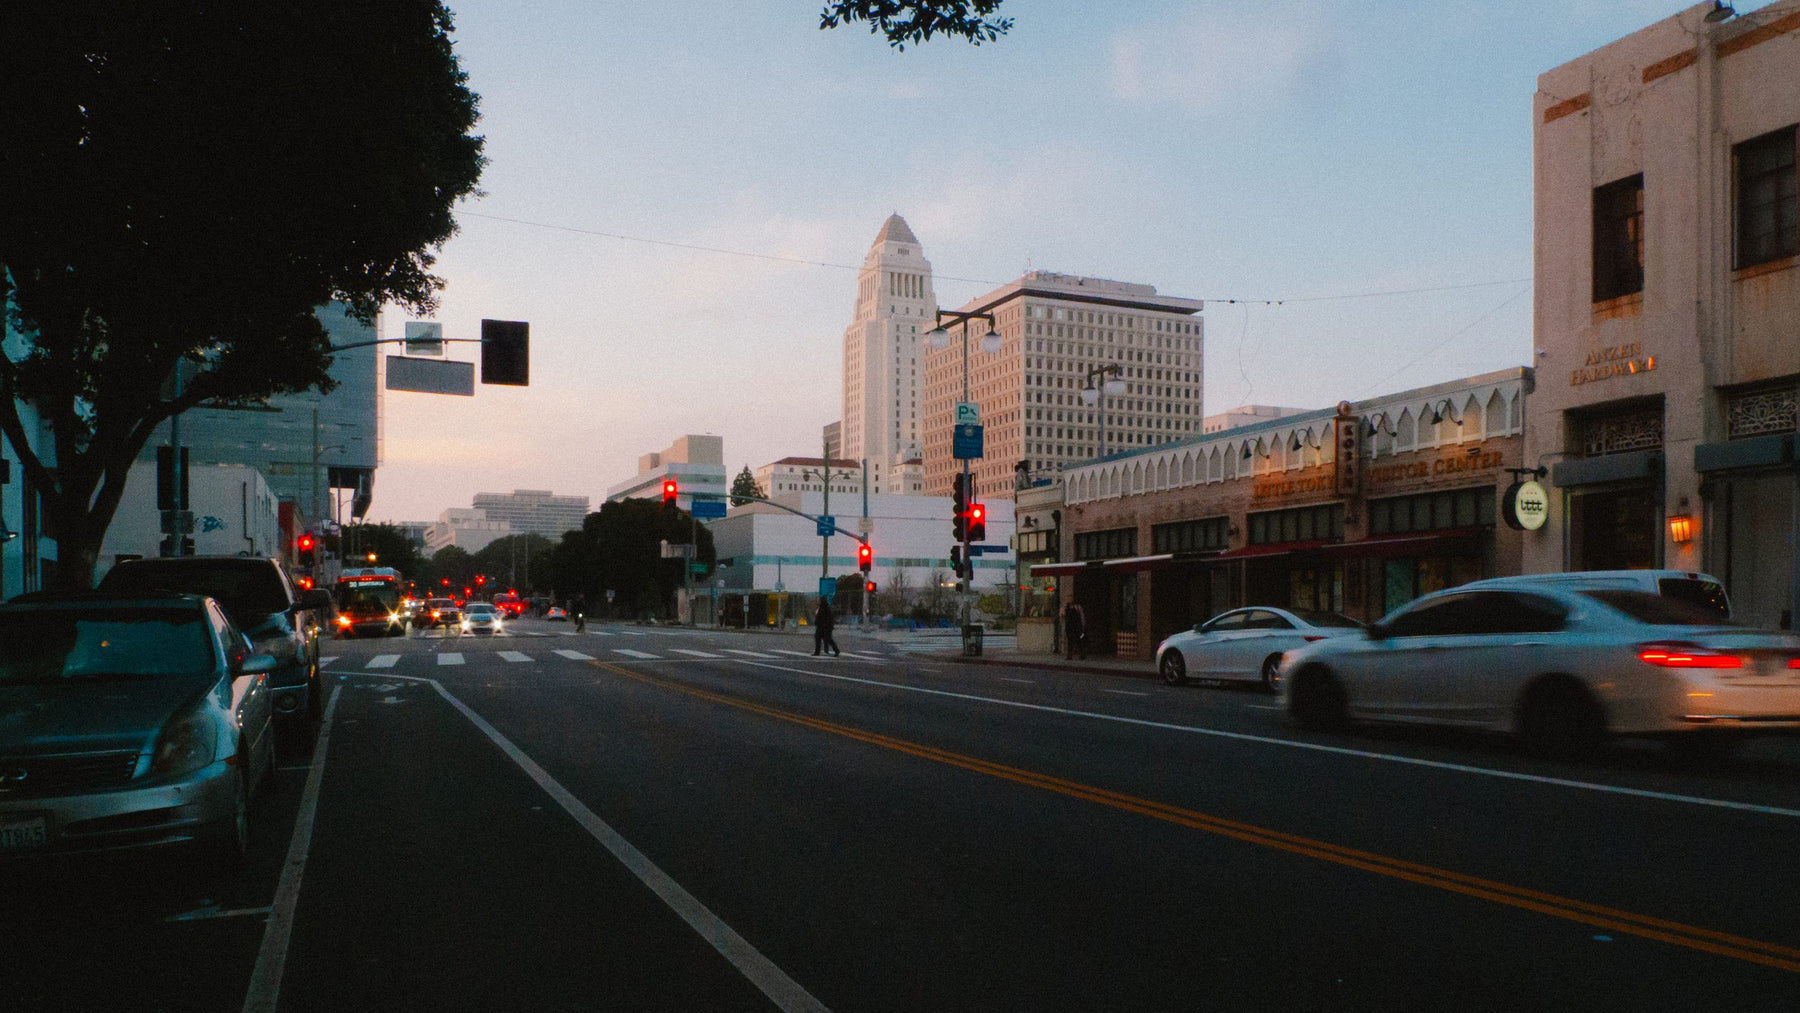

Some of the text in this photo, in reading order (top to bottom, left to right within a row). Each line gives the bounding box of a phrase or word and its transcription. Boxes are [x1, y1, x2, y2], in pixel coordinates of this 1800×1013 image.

[1585, 343, 1641, 367] ANZEN
[1571, 355, 1656, 386] HARDWARE
[959, 405, 970, 420] P
[1253, 480, 1295, 498] LITTLE
[1297, 475, 1335, 493] TOKY
[1433, 450, 1504, 476] CENTER
